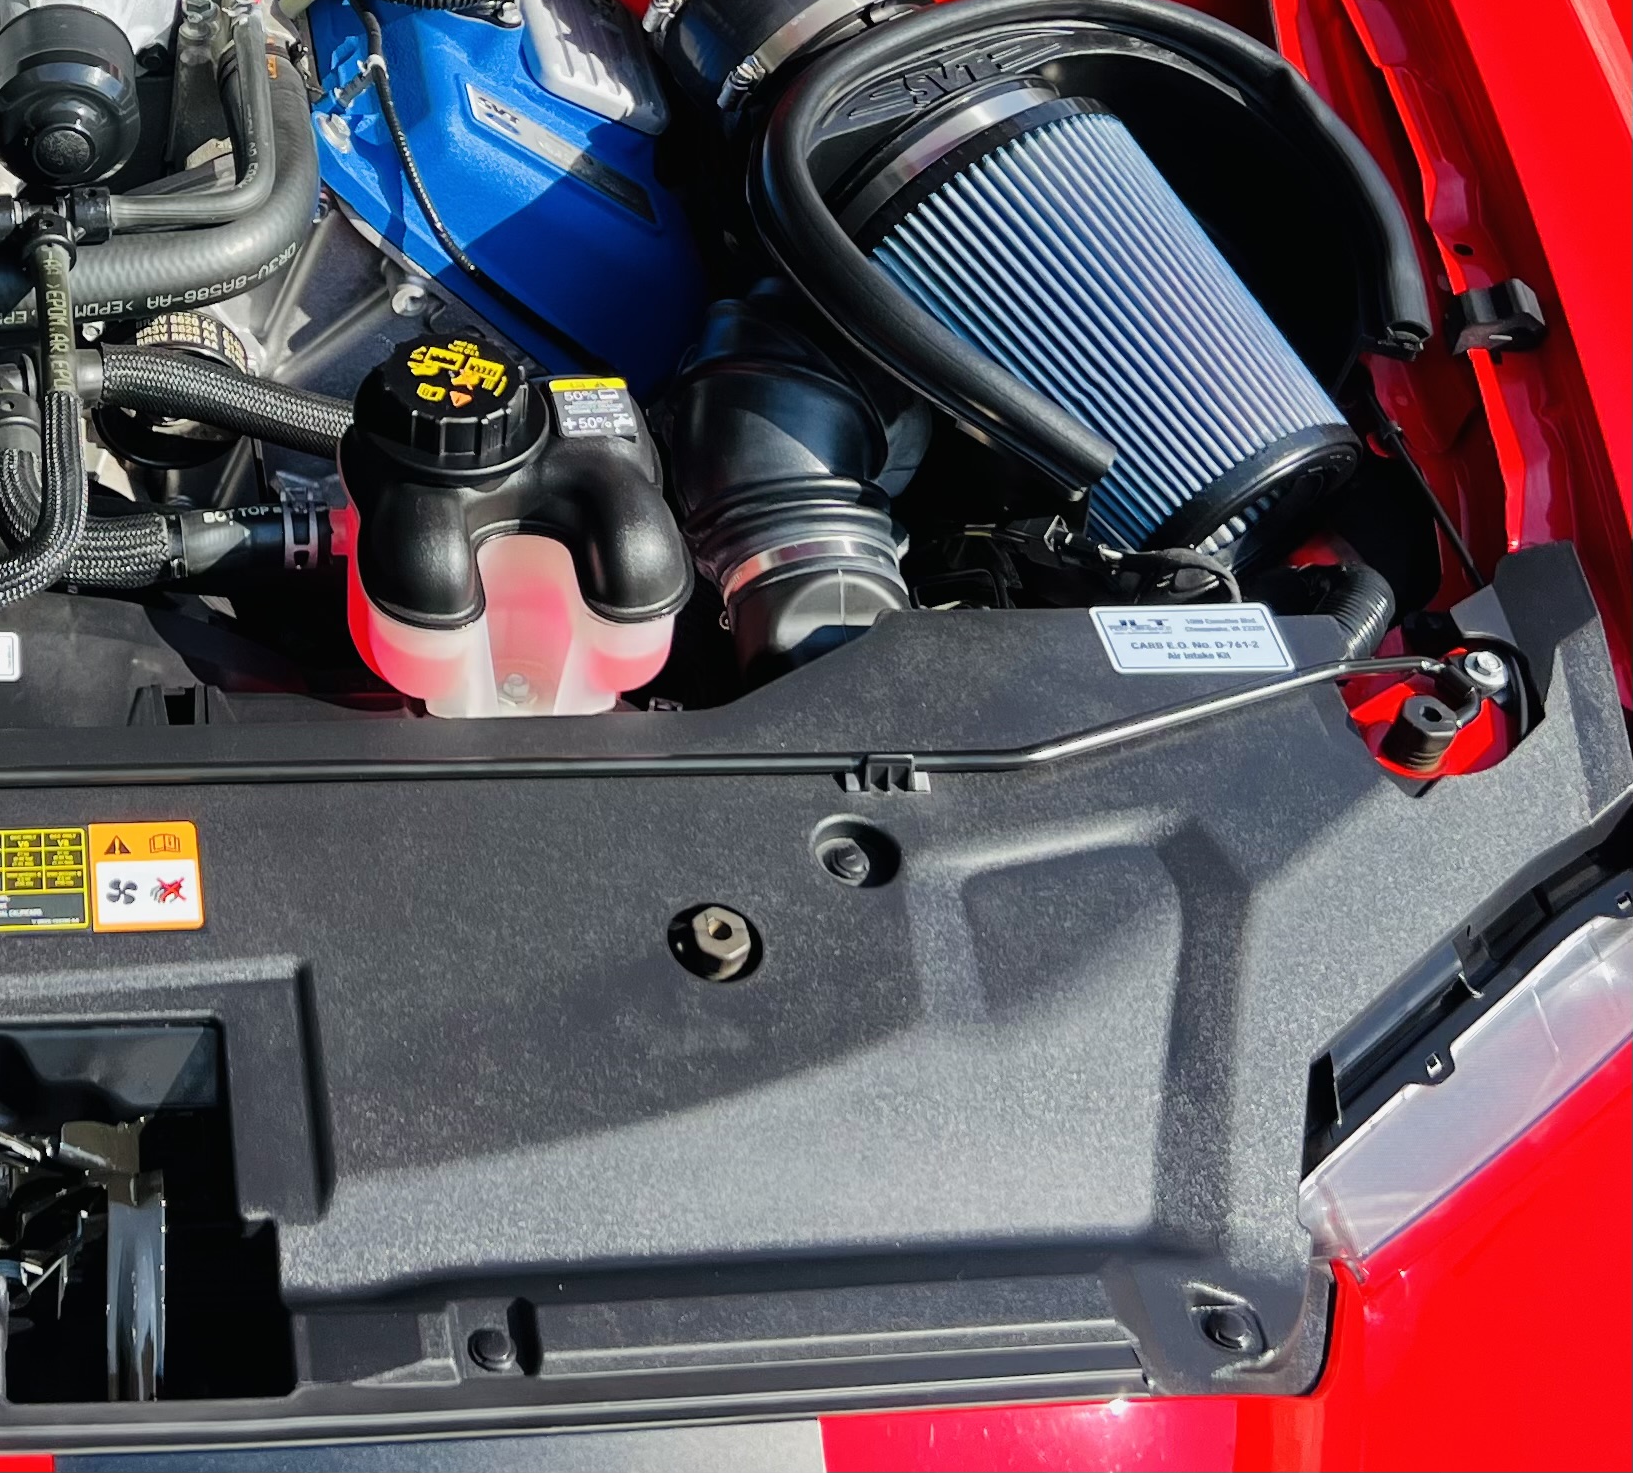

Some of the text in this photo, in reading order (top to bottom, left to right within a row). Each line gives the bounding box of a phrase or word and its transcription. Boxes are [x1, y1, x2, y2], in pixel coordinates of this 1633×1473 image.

[563, 390, 598, 402] 50%
[1130, 640, 1260, 650] CARB E.O. No. D-761-2
[1167, 651, 1232, 660] Air Intake Kit
